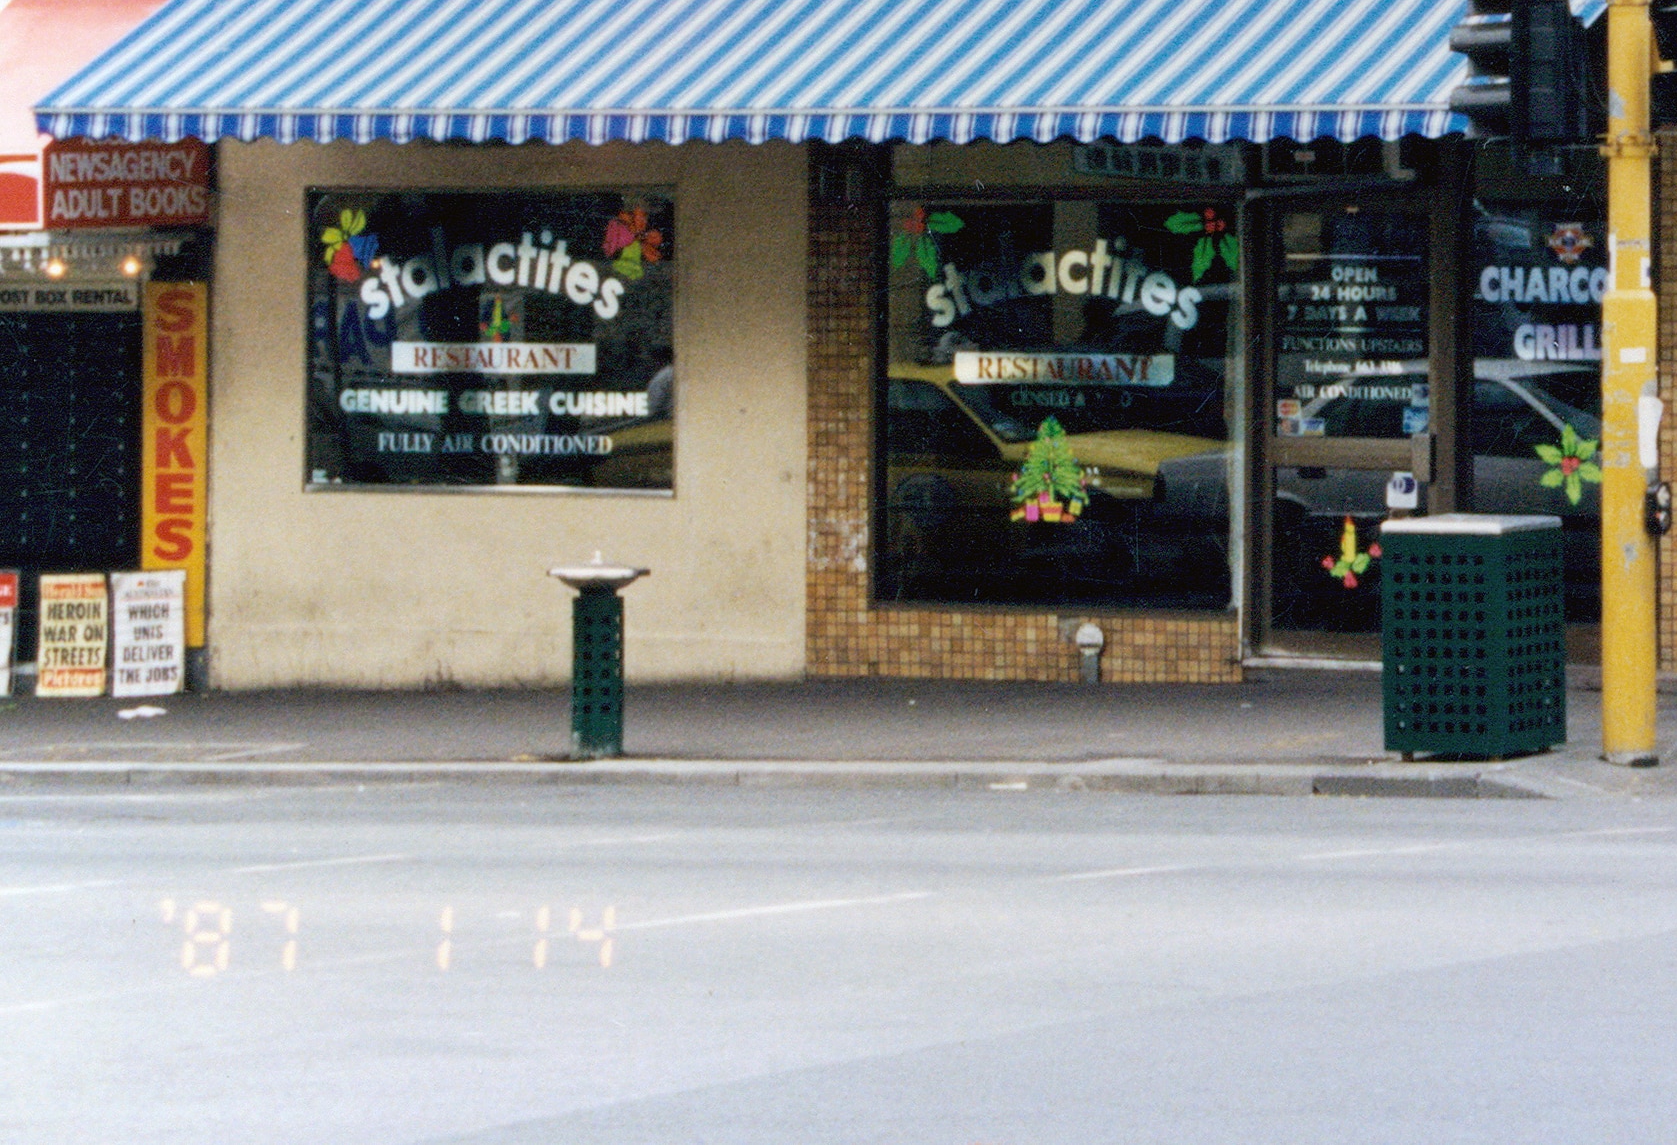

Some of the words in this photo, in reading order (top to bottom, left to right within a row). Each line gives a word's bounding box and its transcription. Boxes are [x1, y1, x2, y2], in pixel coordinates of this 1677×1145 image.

[50, 150, 197, 183] NEWSAGENCY
[51, 188, 123, 220] ADULT
[129, 184, 207, 217] BOOKS
[360, 230, 625, 320] stalactites
[926, 237, 1202, 330] stalactites
[1331, 266, 1378, 282] OPEN
[35, 289, 67, 304] BOX
[72, 289, 132, 304] RENTAL
[1311, 286, 1331, 301] 24
[1337, 286, 1397, 302] HOURS
[1354, 306, 1368, 321] A
[413, 345, 577, 370] RESTAURANT
[977, 356, 1152, 382] RESTAURANT
[340, 389, 448, 415] GENUINE
[460, 391, 540, 416] GREEK
[549, 391, 648, 416] CUISINE
[1319, 386, 1412, 400] CONDITIONED
[154, 289, 197, 562] SMOKES
[377, 432, 432, 453] FULLY
[442, 434, 473, 453] AIR
[481, 434, 613, 455] CONDITIONED
[47, 602, 100, 621] HEROIN
[128, 604, 170, 621] WHICH
[44, 626, 77, 643] WAR
[84, 624, 104, 641] ON
[134, 625, 164, 641] UNIS
[44, 647, 101, 666] STREETS
[123, 646, 174, 663] DELIVER
[119, 669, 141, 684] THE
[146, 666, 178, 683] JOBS
